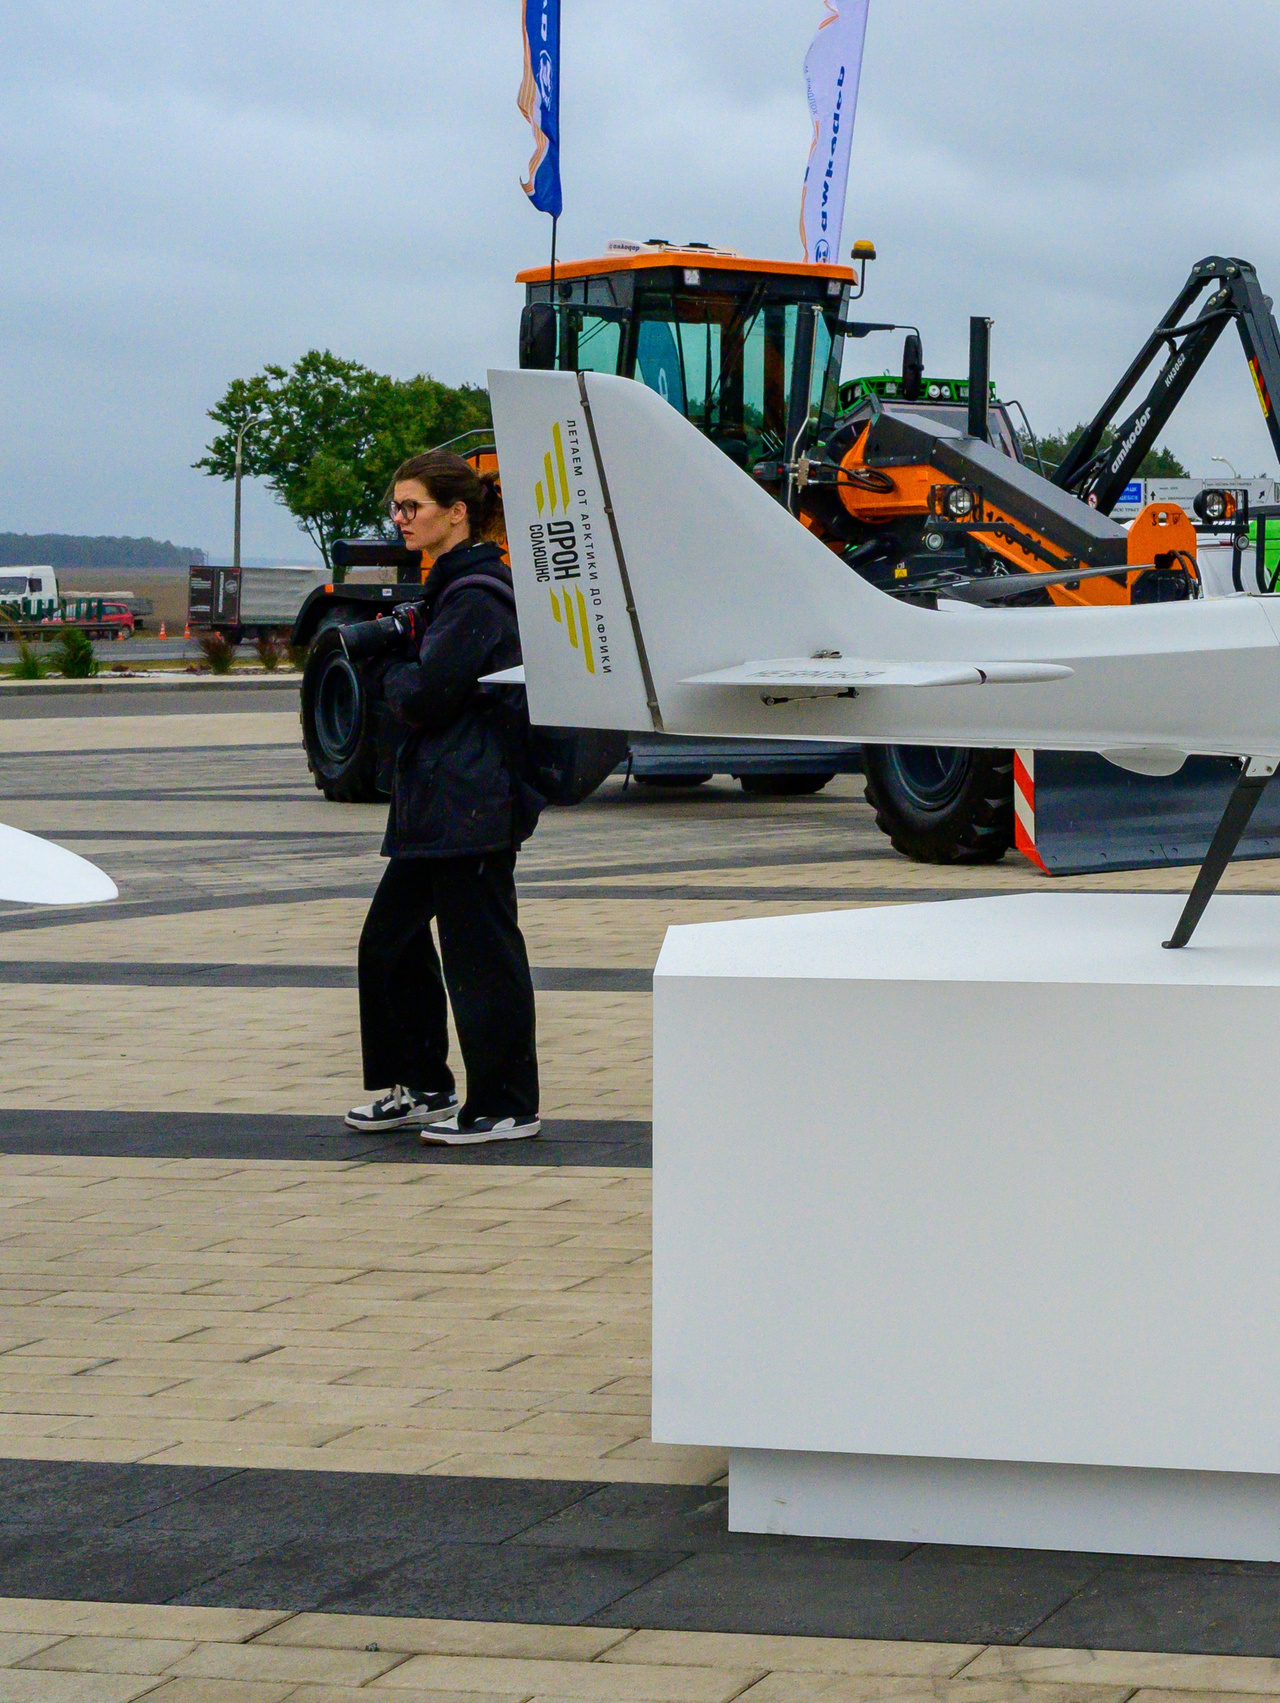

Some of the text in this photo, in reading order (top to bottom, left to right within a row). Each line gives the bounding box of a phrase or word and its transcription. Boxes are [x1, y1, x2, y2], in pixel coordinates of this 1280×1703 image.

[1164, 352, 1186, 387] KH3052
[1111, 406, 1151, 474] amkodor
[547, 520, 581, 580] ДРОН
[567, 419, 612, 674] ЛЕТАЕМ ОТ АРКТИКИ ДО АФРИКИ
